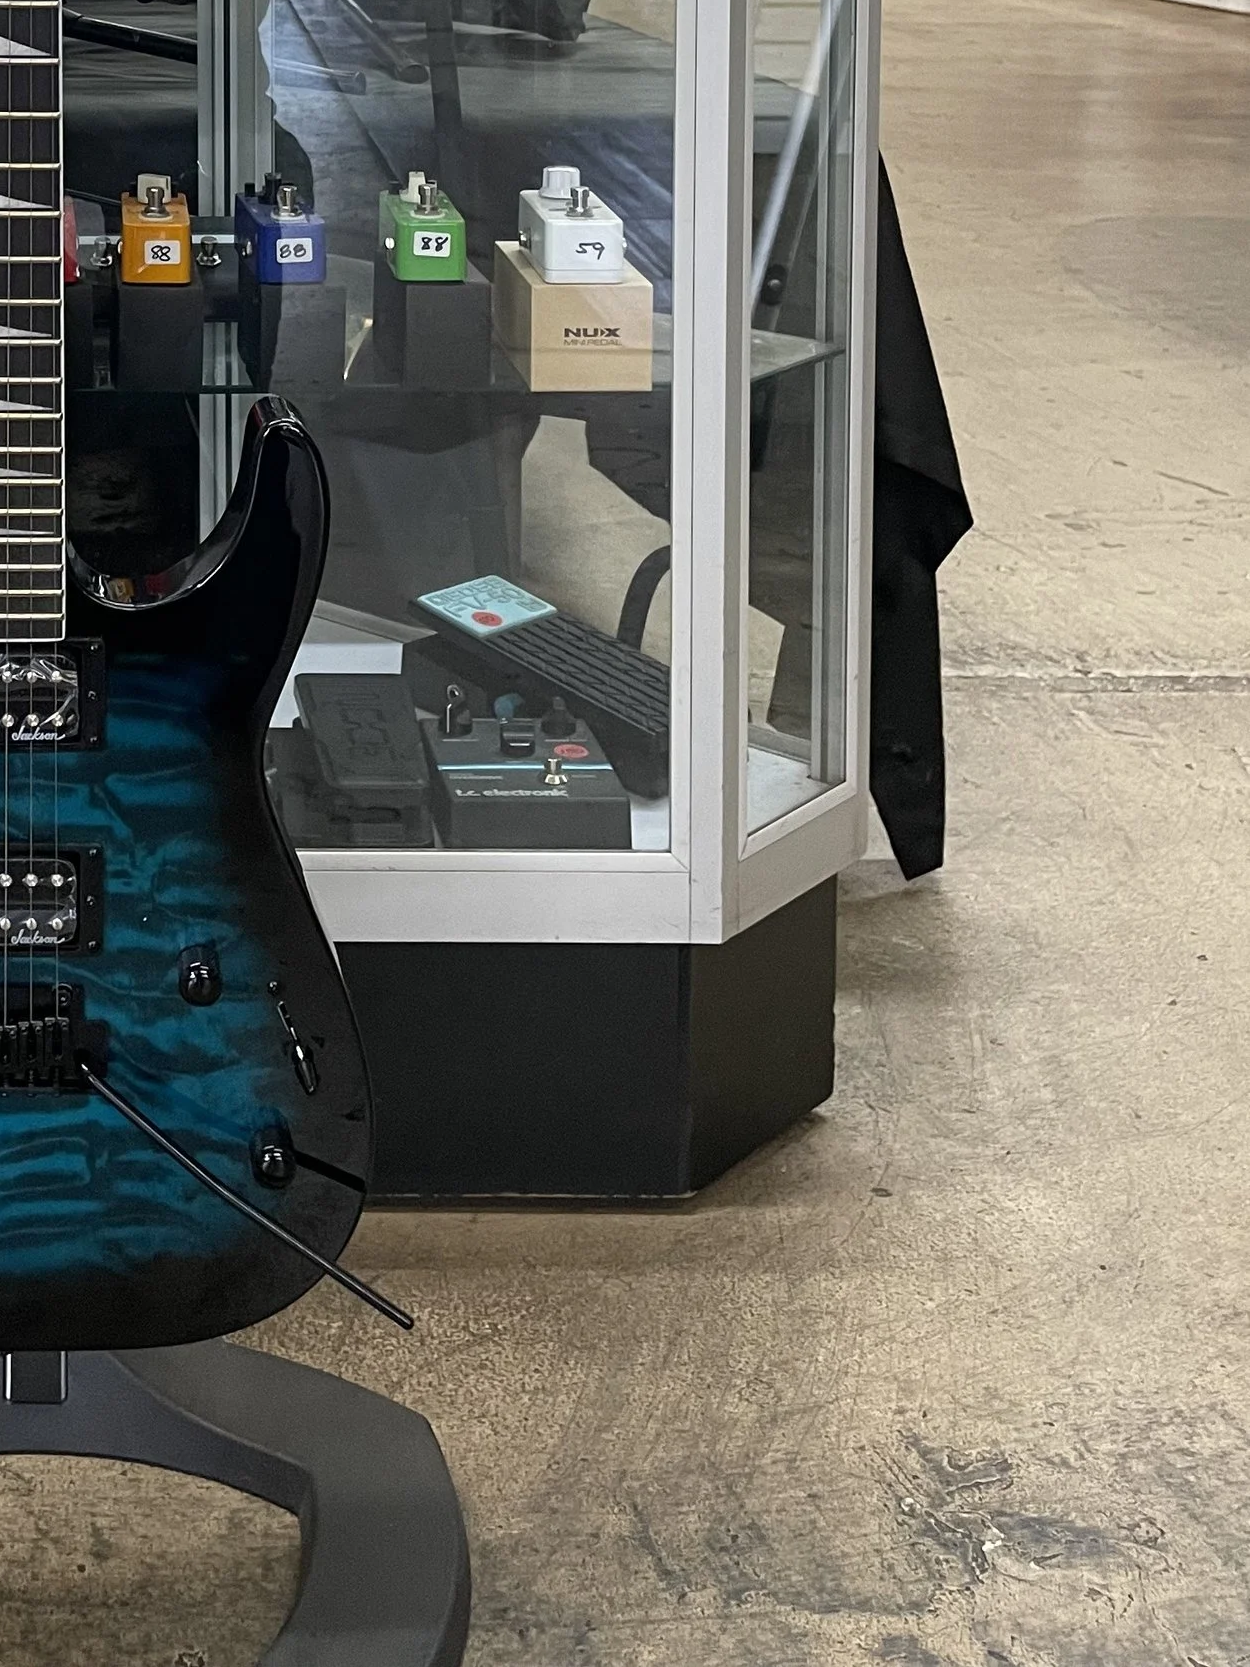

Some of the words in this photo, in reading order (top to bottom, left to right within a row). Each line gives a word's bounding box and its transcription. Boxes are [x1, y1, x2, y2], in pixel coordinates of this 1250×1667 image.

[421, 236, 449, 252] 88
[575, 241, 606, 261] 59
[150, 245, 171, 262] 88
[564, 327, 621, 338] NUX
[11, 726, 66, 741] Jackson
[483, 788, 569, 797] electronic
[11, 929, 66, 946] Jackson
